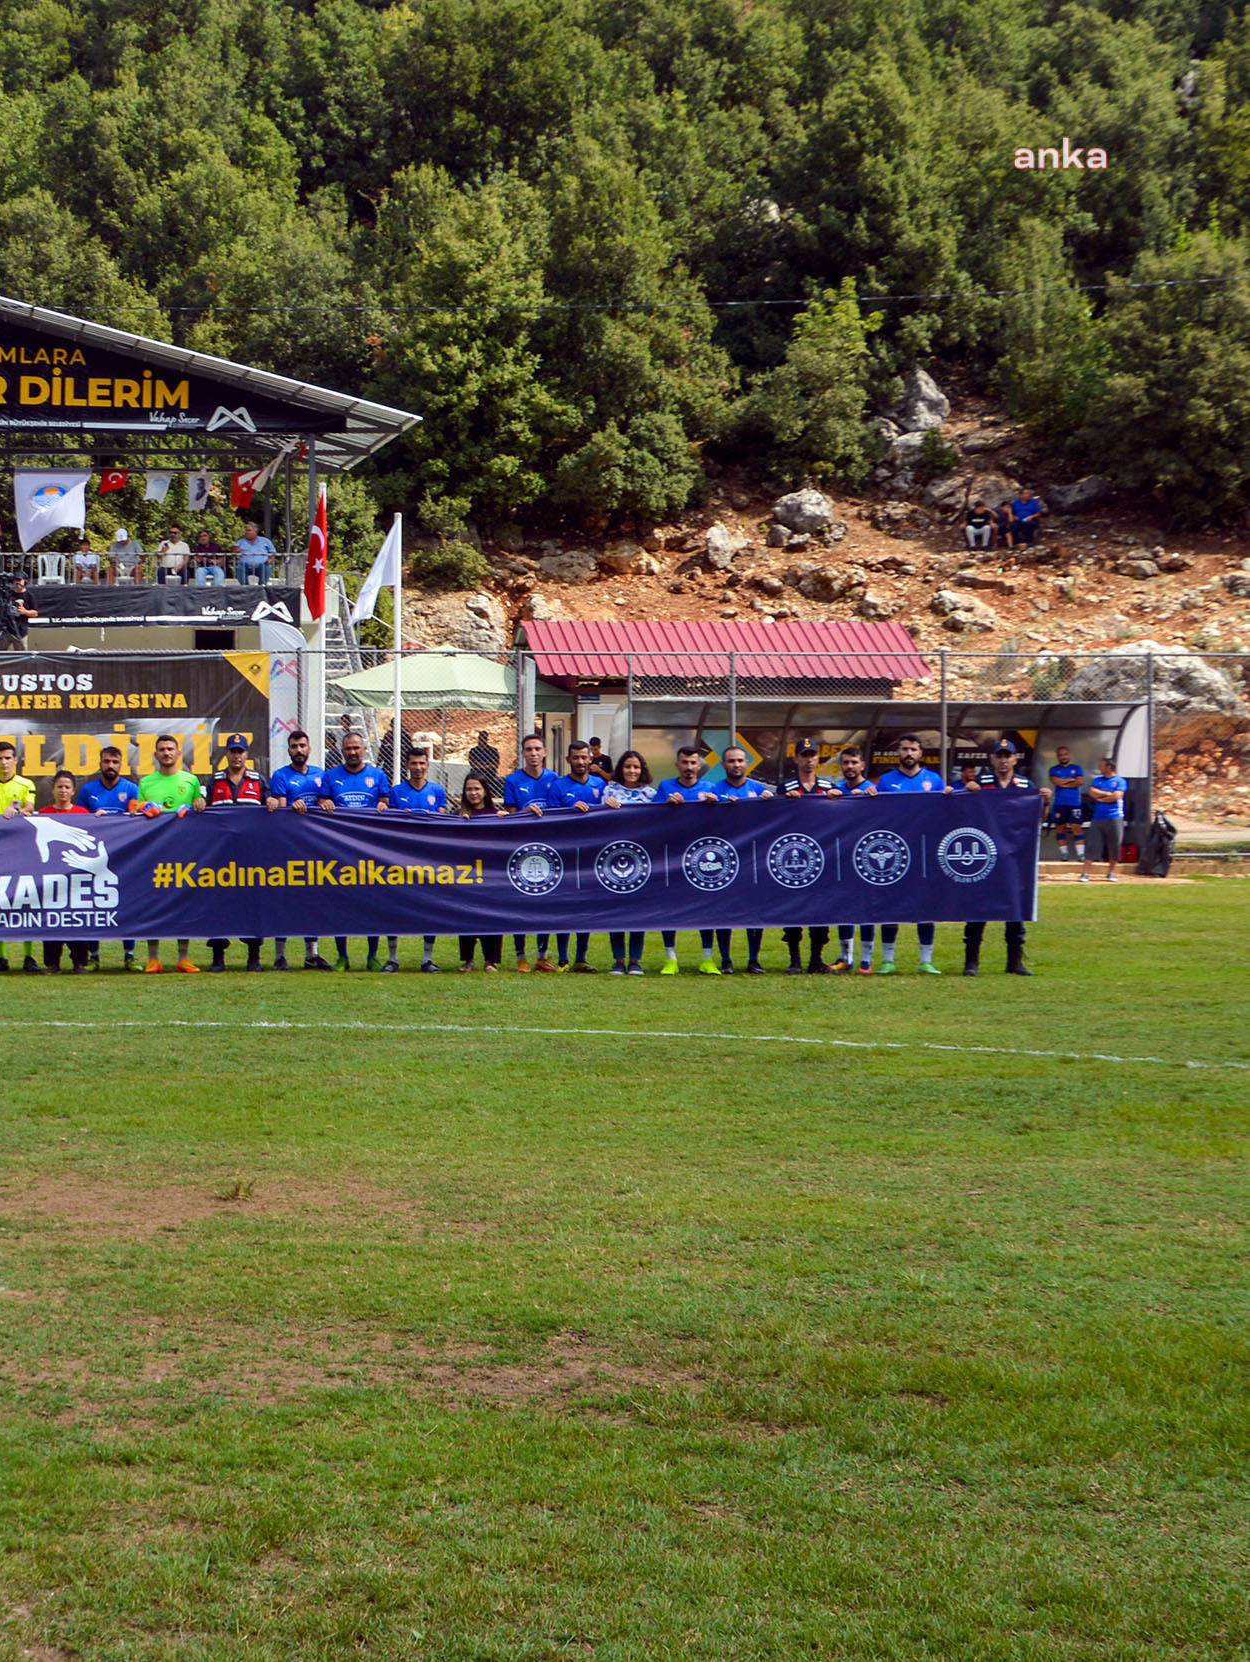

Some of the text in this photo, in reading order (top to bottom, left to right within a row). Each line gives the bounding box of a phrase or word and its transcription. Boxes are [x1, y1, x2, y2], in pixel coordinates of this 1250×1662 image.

[19, 367, 190, 409] DİLERİM
[69, 693, 189, 709] KUPASI'NA
[152, 859, 484, 888] #KadınaElKalkamaz!
[46, 911, 119, 927] DESTEK
